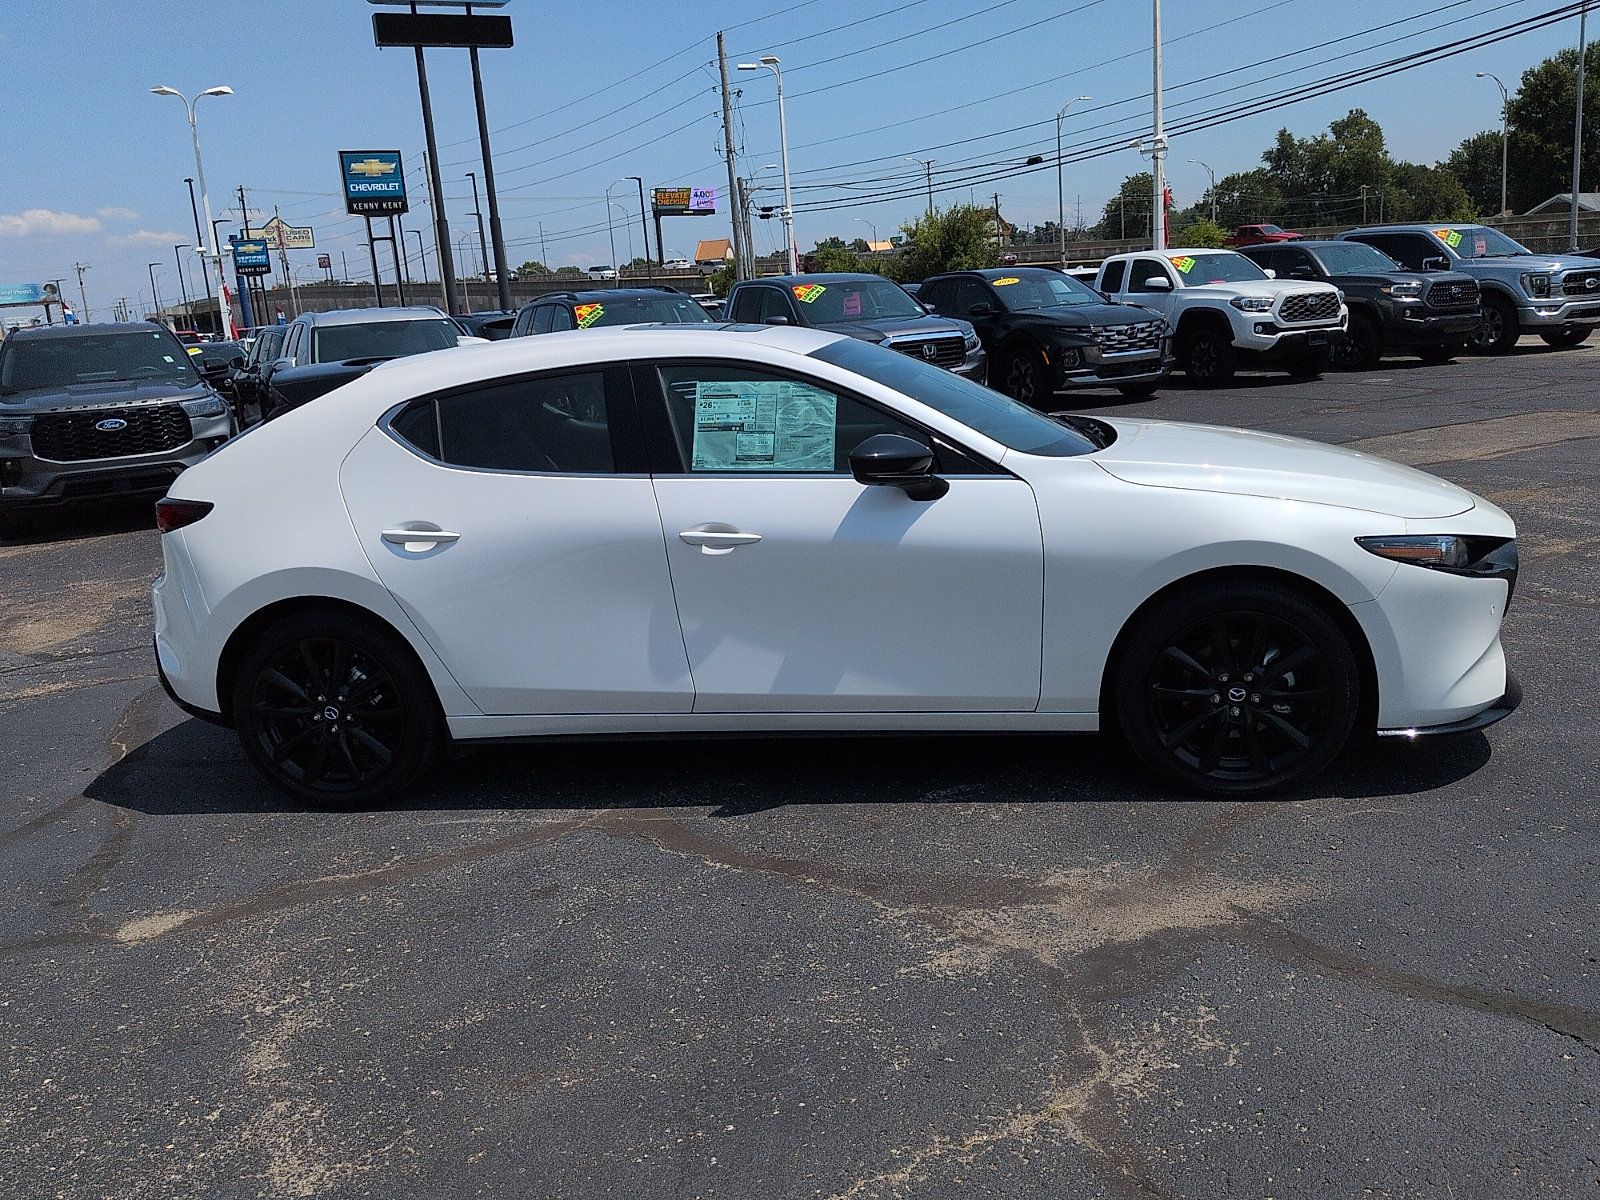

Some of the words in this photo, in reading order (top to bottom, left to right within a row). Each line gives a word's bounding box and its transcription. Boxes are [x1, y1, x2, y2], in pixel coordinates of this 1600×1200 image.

[350, 182, 400, 192] CHEVROLET
[352, 202, 379, 210] KENNY
[382, 201, 403, 209] KENT
[657, 198, 689, 206] CHECKING
